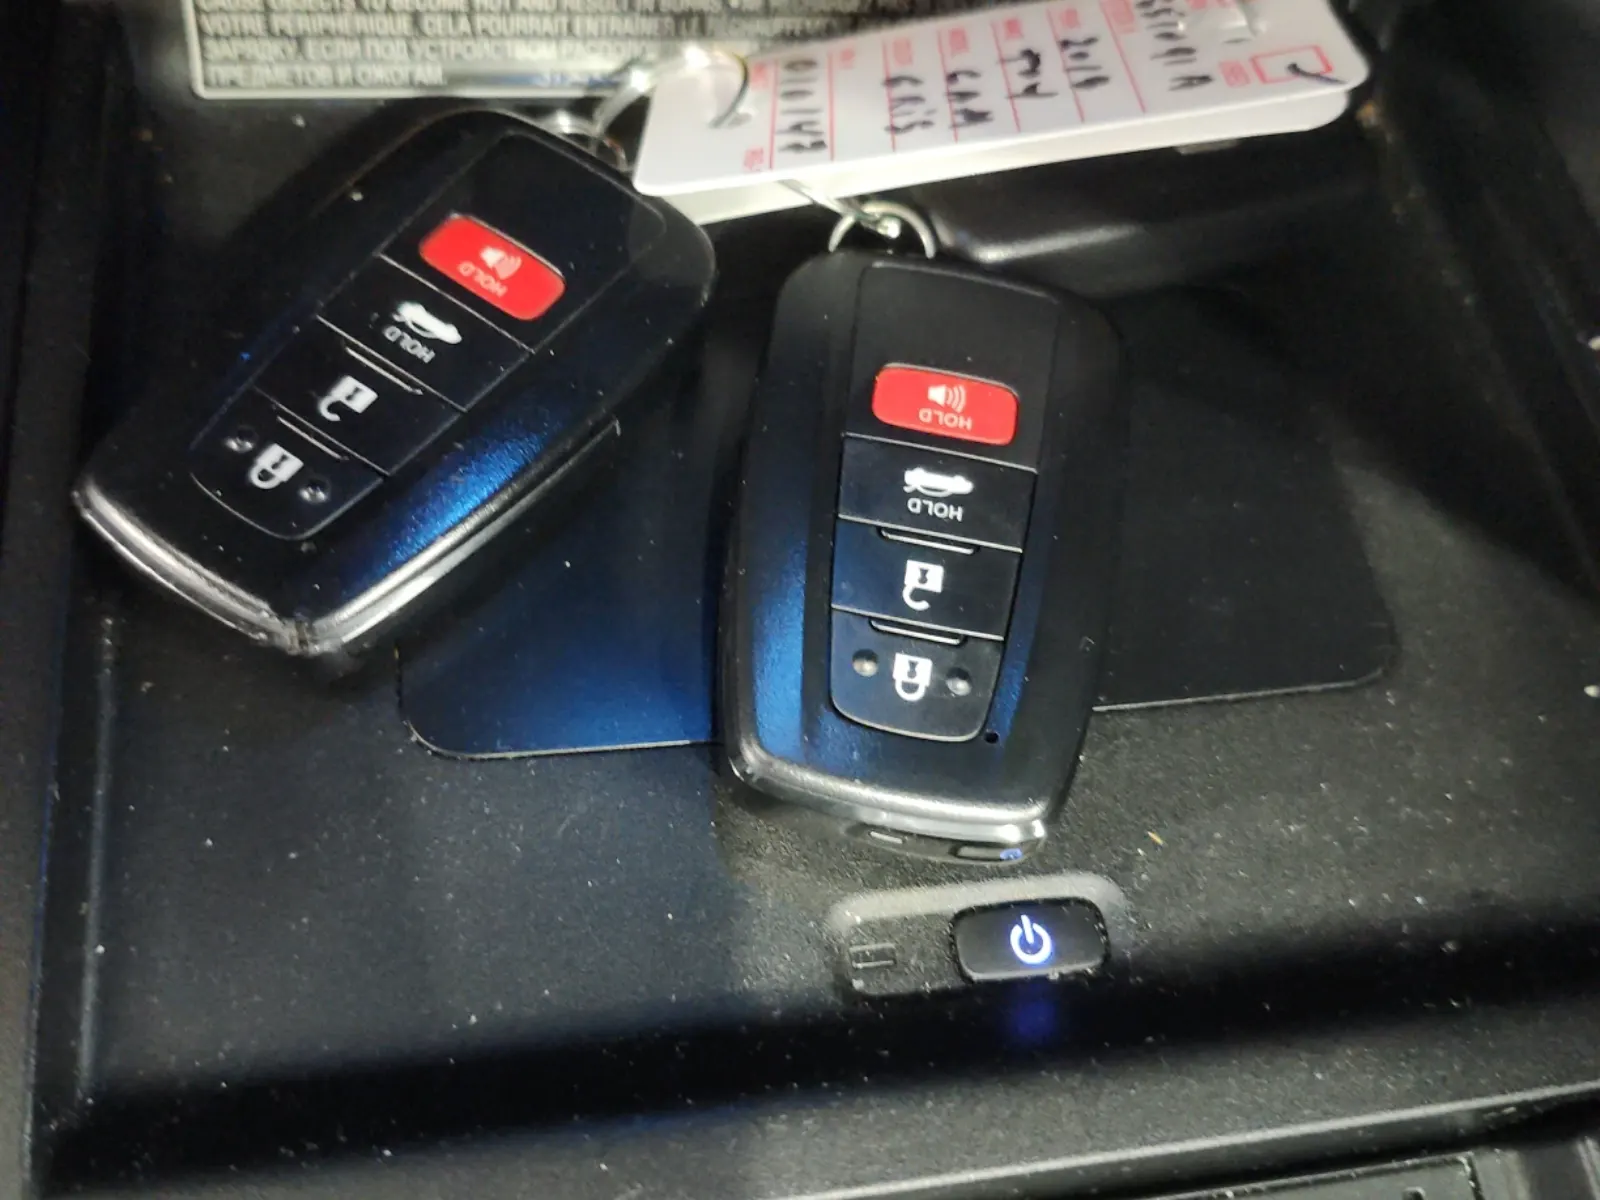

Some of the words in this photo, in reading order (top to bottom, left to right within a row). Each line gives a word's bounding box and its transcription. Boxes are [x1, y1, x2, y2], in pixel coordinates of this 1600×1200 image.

[457, 261, 508, 298] HOLD
[383, 325, 436, 364] HOLD
[918, 407, 973, 431] HOLD
[906, 497, 964, 522] HOLD
